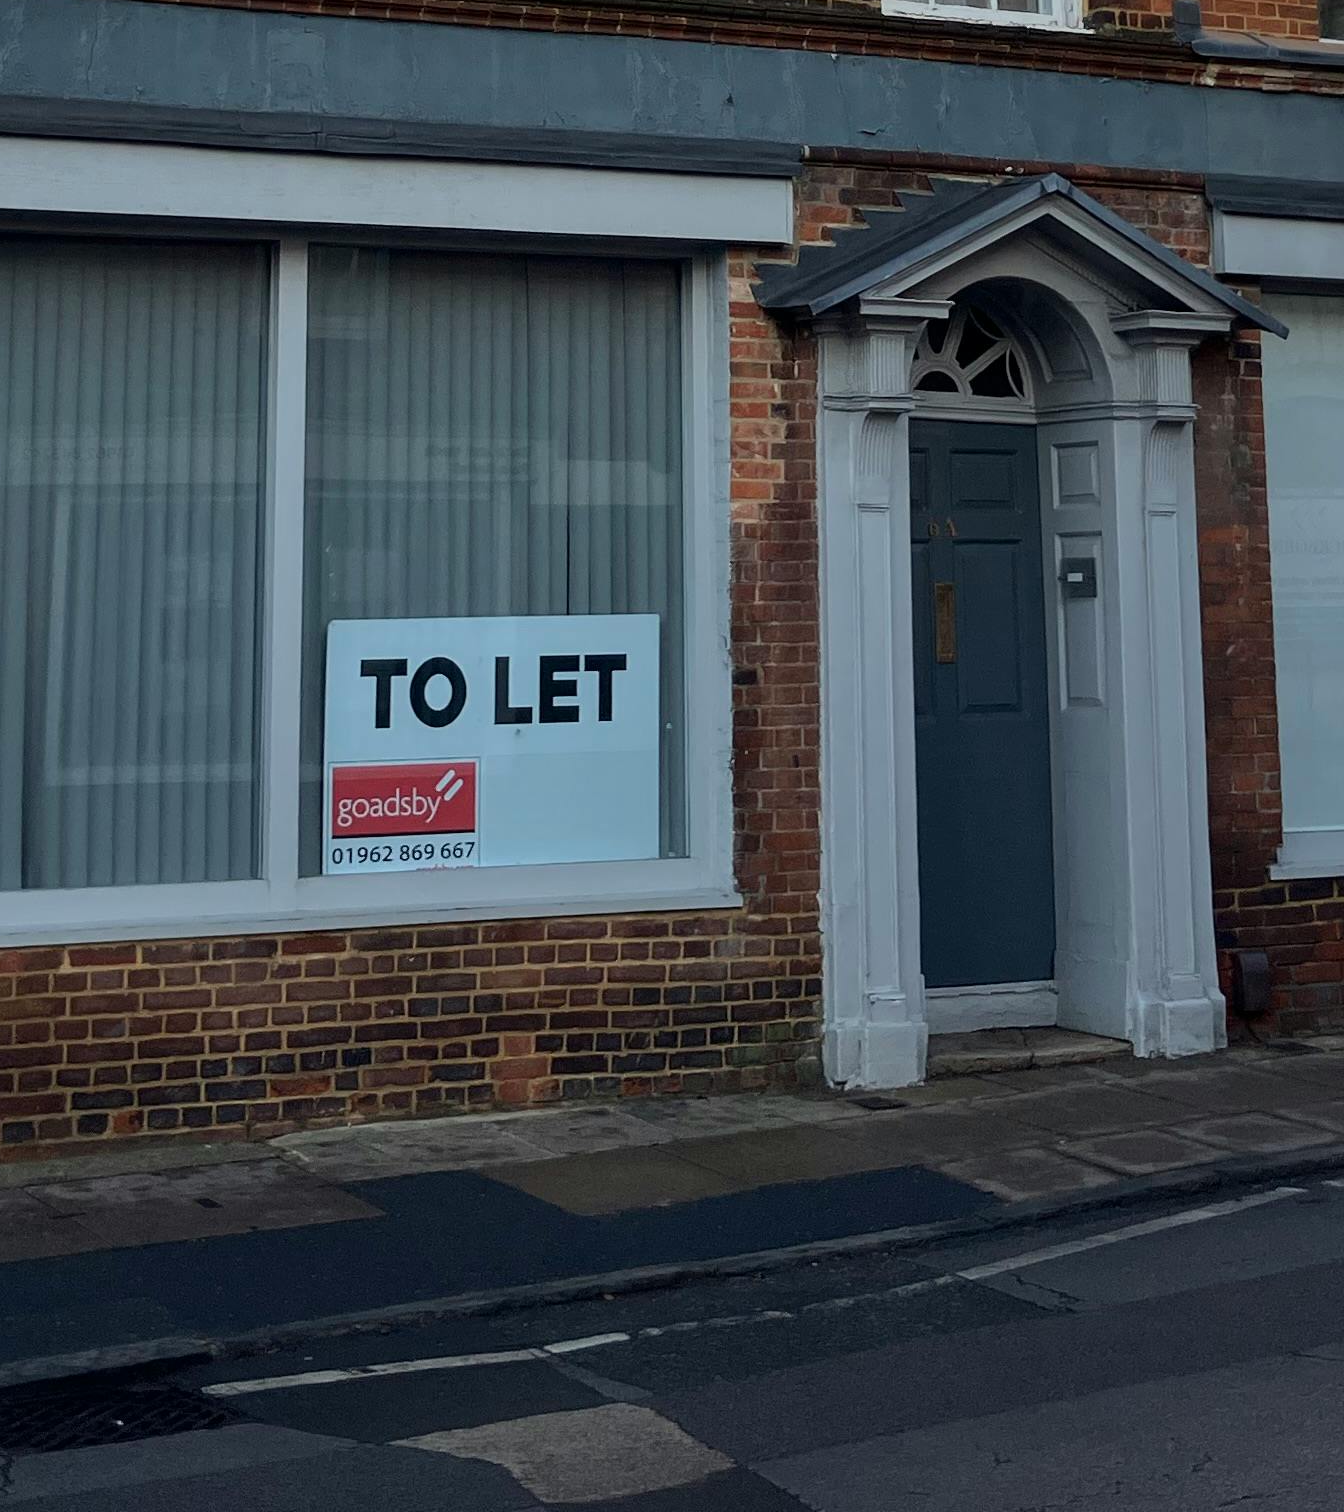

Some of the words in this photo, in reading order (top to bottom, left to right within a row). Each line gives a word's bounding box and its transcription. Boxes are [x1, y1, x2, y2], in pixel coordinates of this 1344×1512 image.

[360, 656, 468, 729] TO
[494, 653, 627, 725] LET
[337, 787, 442, 828] goadsby
[332, 845, 393, 865] 01962
[399, 843, 435, 862] 869
[440, 841, 475, 860] 667
